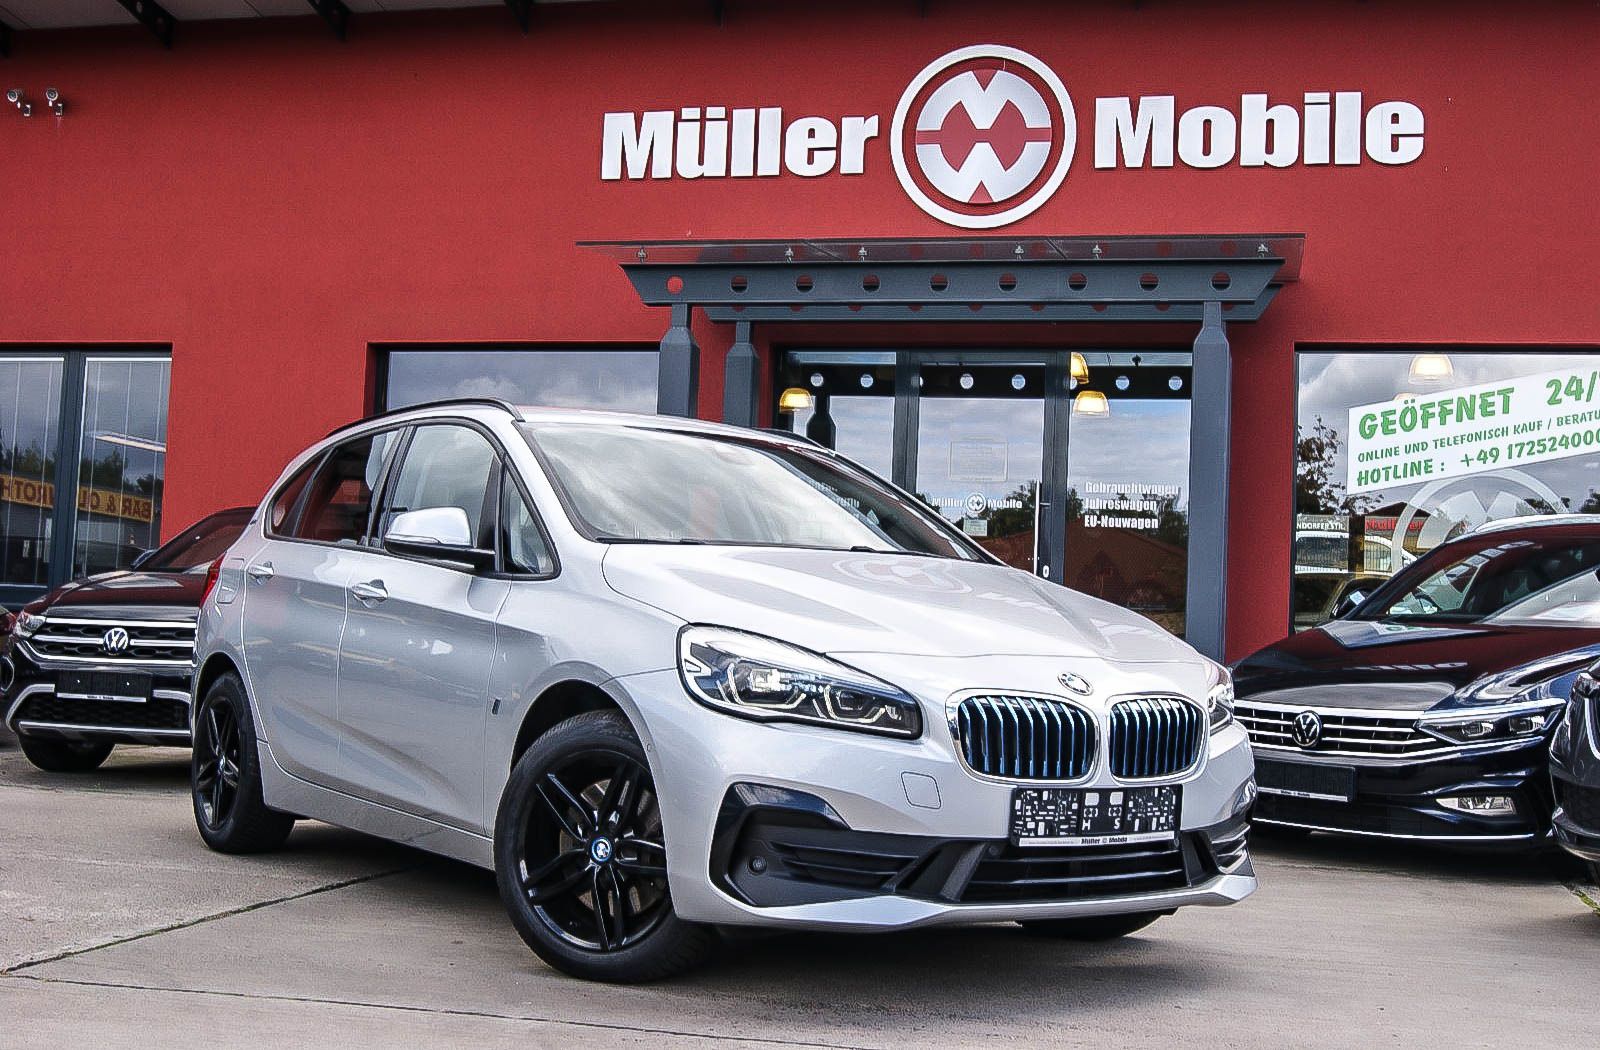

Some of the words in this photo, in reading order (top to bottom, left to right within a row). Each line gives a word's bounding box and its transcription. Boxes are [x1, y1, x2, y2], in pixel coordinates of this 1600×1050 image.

[600, 106, 879, 181] Müller
[1094, 91, 1425, 169] Mobile
[1359, 386, 1514, 440] GEÖFFNET
[1546, 370, 1600, 405] 24/
[1358, 446, 1400, 462] ONLINE
[1404, 441, 1428, 454] UND
[1432, 426, 1508, 450] TELEFONISCH
[1513, 420, 1543, 435] KAUF
[1556, 409, 1600, 427] BERATU
[1357, 459, 1433, 486] HOTLINE
[1460, 447, 1500, 467] +49
[987, 499, 1023, 509] Mobile
[1083, 498, 1157, 512] Jahreswagen
[1084, 515, 1159, 530] EU-Neuwagen
